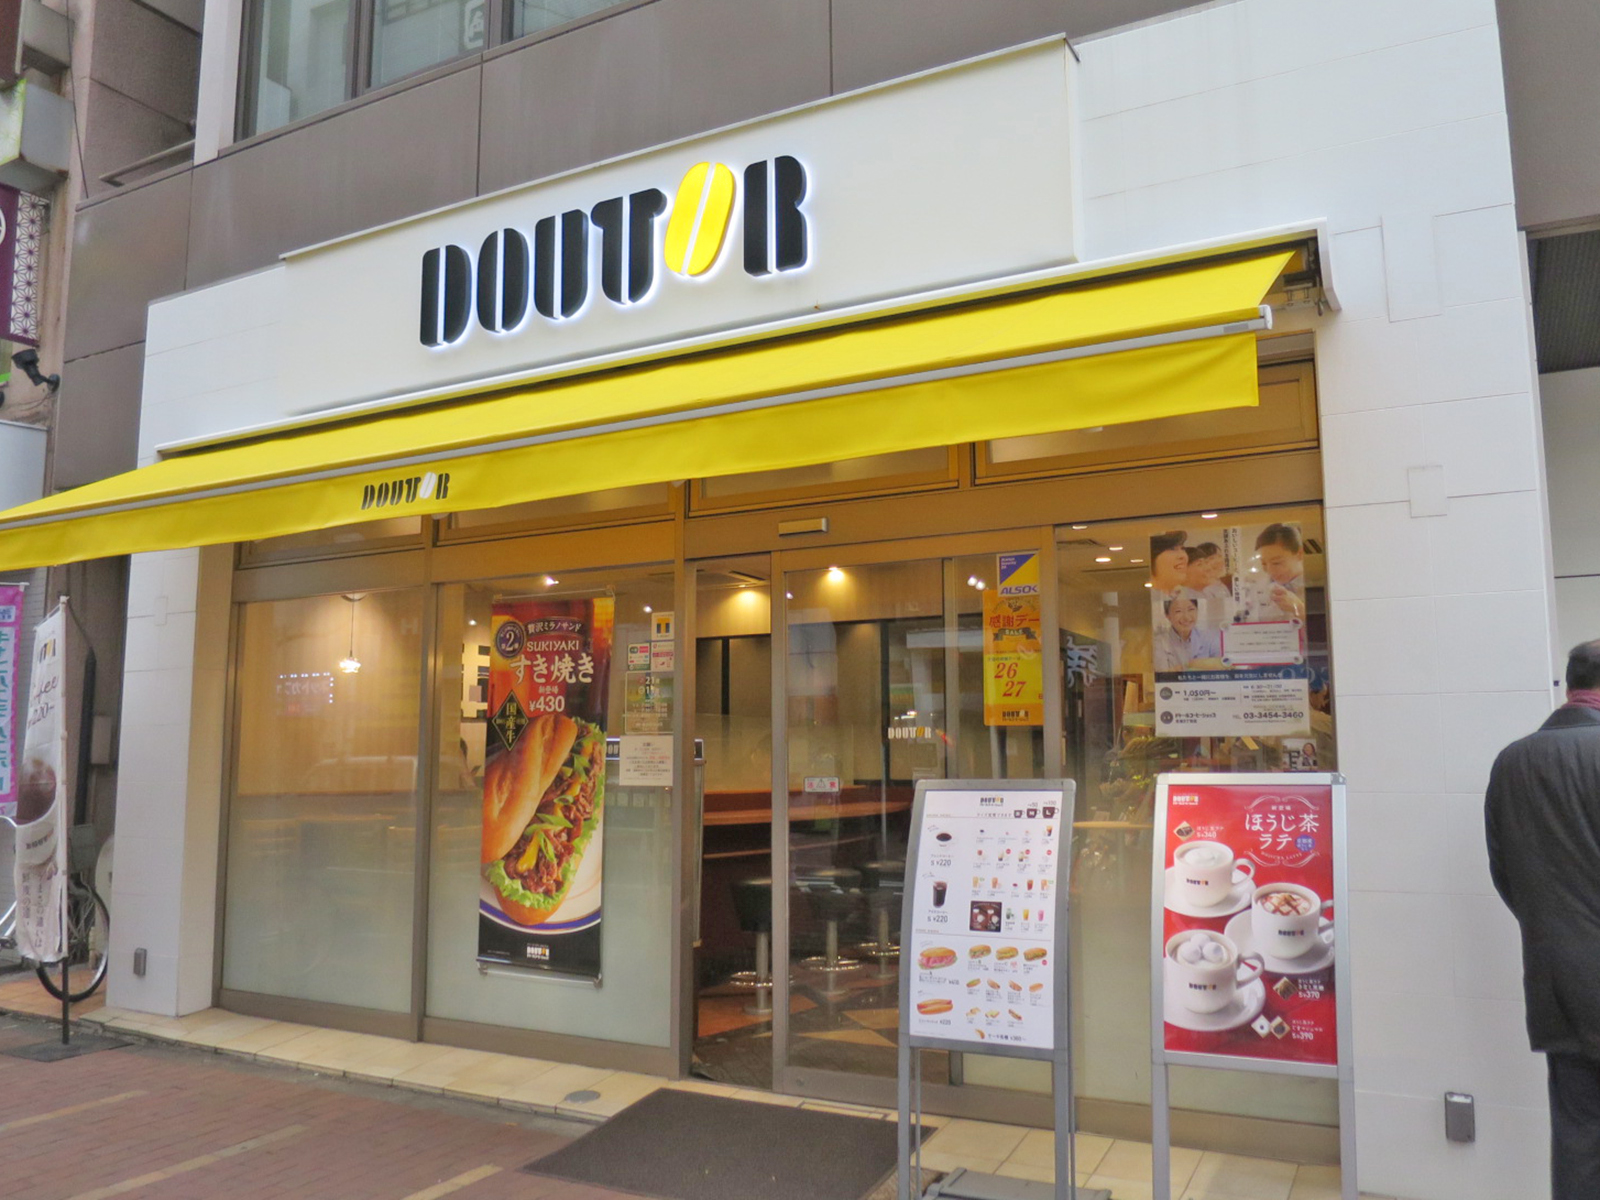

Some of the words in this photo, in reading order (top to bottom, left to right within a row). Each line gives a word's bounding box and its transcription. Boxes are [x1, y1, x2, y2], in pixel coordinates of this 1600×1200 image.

[419, 155, 808, 348] DOUTOR
[361, 471, 450, 510] DOUTOR
[1000, 584, 1038, 596] ALSOK
[527, 621, 583, 635] 贅沢ミラノサンド
[526, 640, 580, 652] SUKIYAKI
[510, 652, 595, 684] すき焼き
[994, 662, 1019, 679] 26
[1002, 680, 1027, 697] 27
[528, 696, 566, 712] ¥430
[1243, 712, 1304, 720] 03-3454-3460
[888, 726, 932, 740] DOUTOR
[1245, 813, 1320, 833] ほうじ茶
[1259, 833, 1293, 851] ラテ
